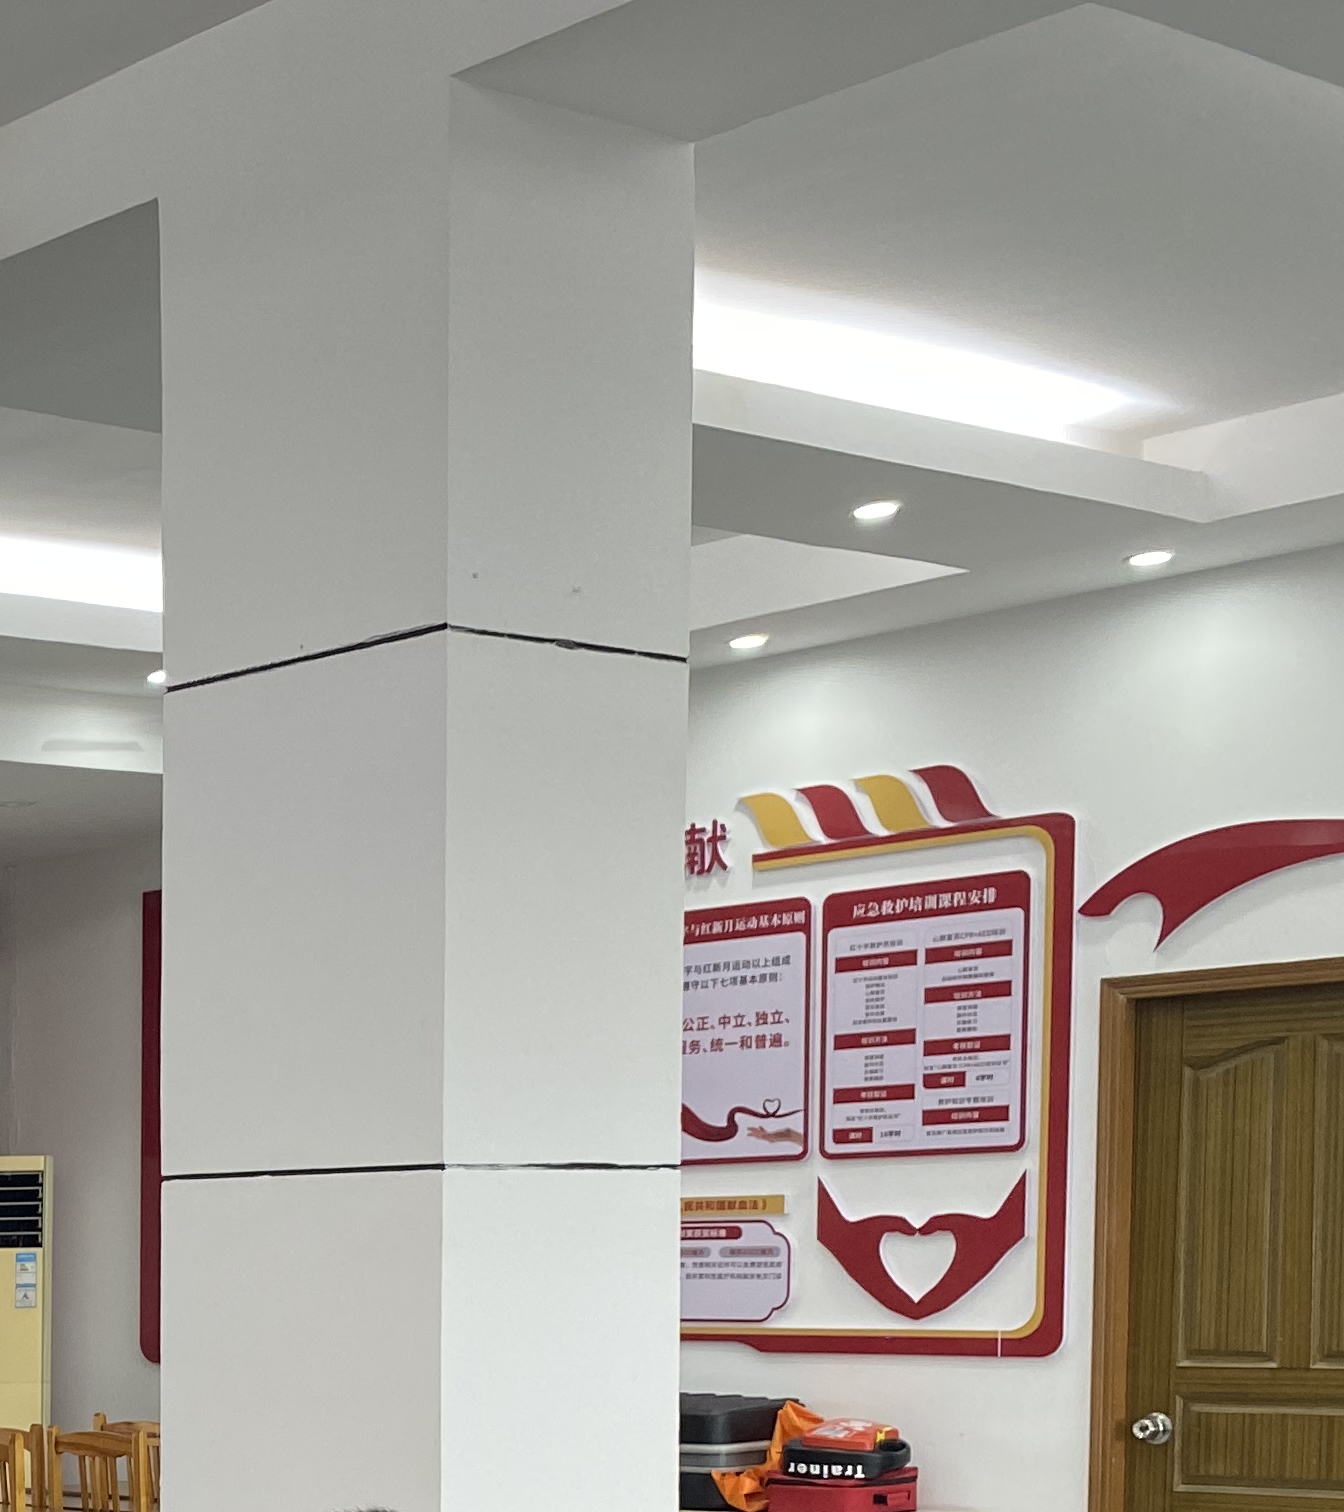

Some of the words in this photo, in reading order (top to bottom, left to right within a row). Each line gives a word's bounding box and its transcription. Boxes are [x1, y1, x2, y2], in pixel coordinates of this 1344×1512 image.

[685, 819, 728, 876] 献
[852, 887, 998, 919] 应急救护培训课程安排
[788, 1462, 866, 1479] Trainer
